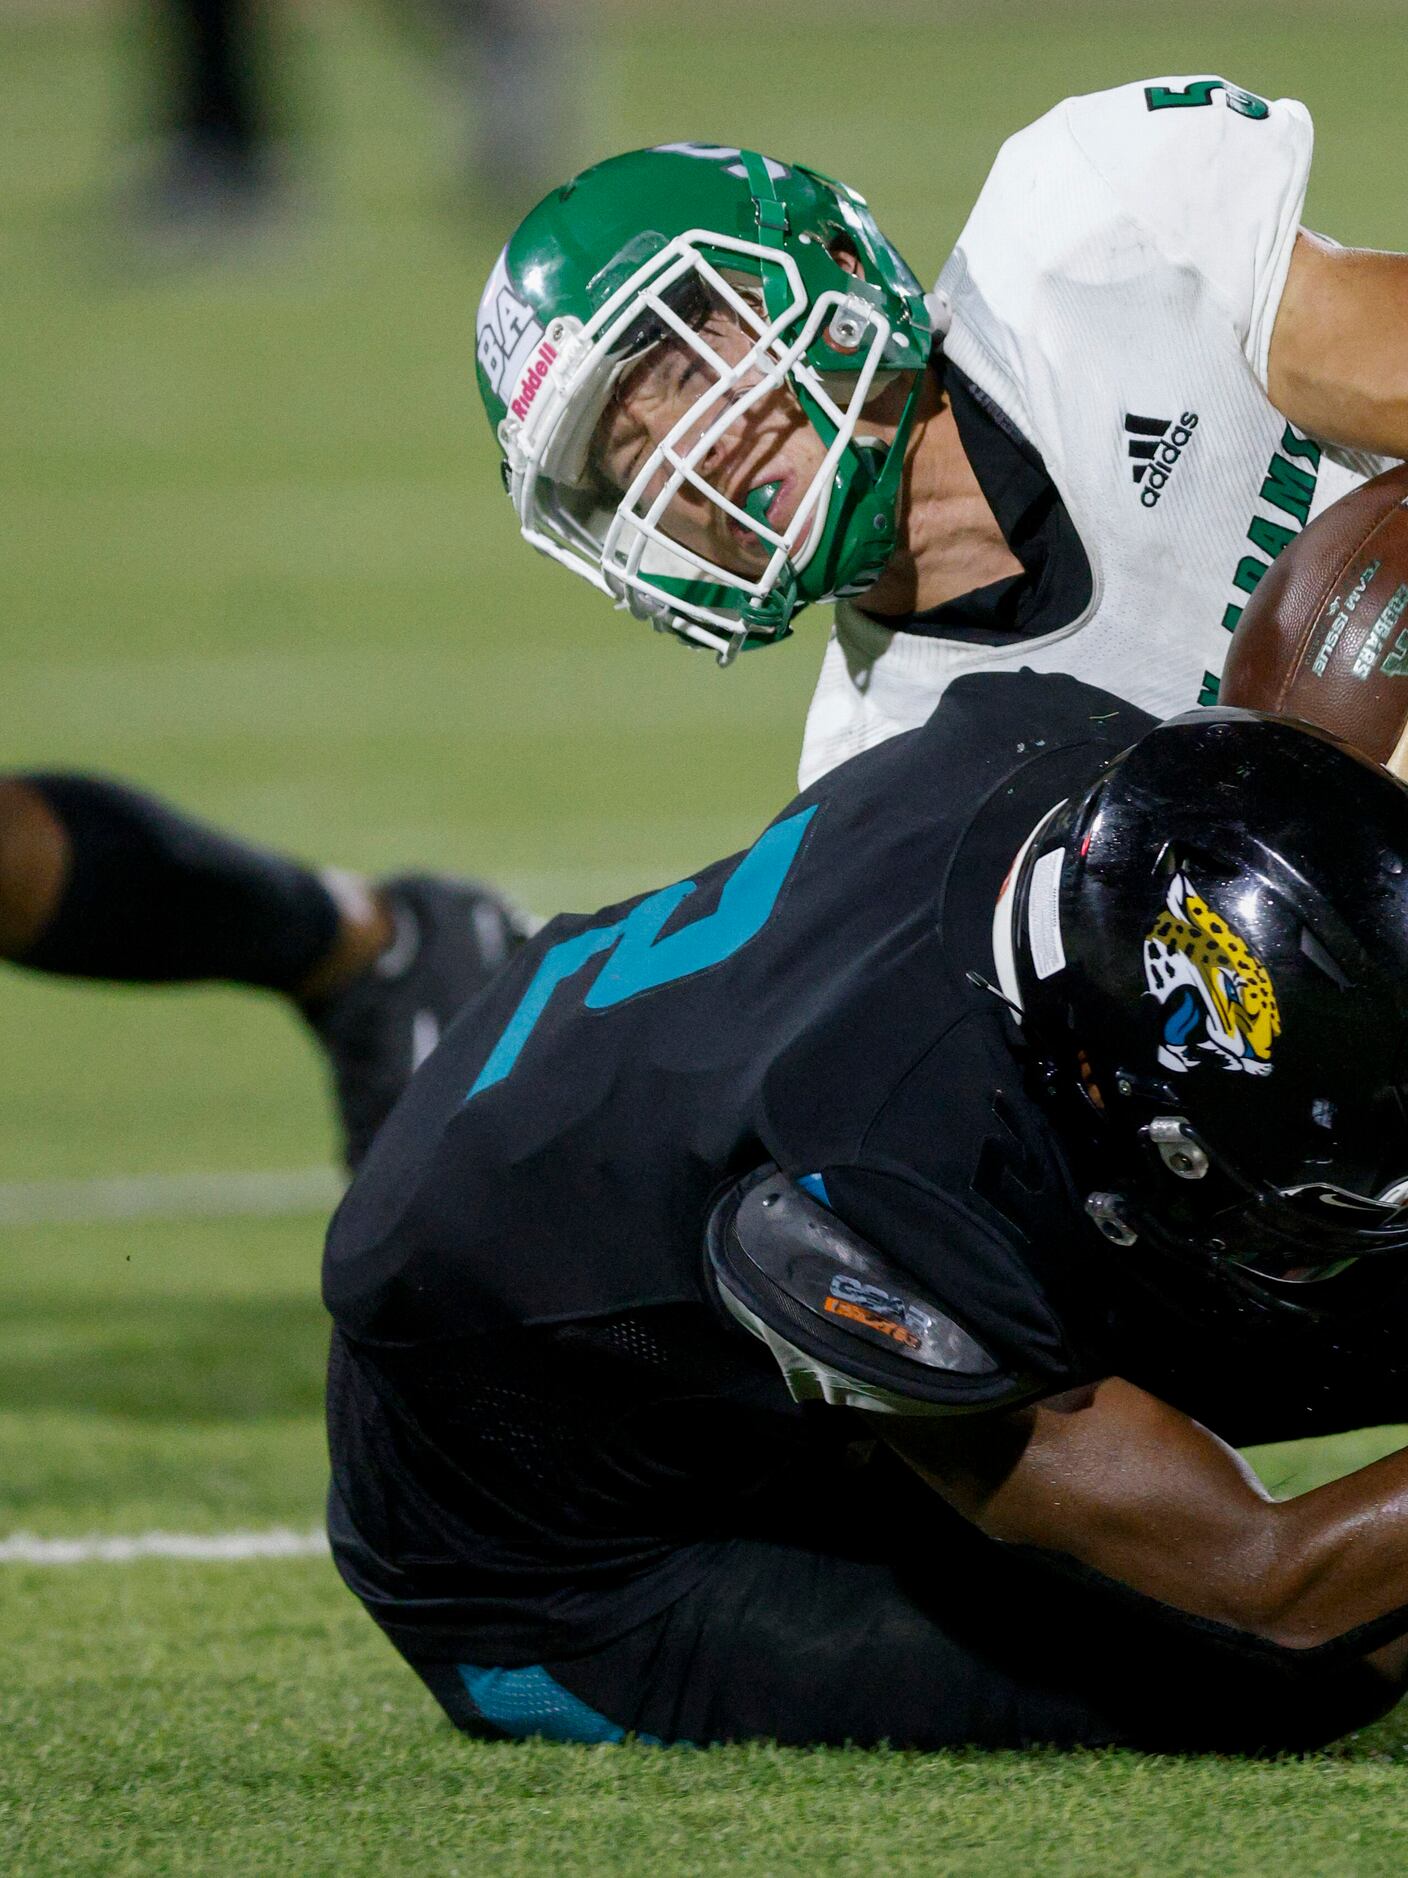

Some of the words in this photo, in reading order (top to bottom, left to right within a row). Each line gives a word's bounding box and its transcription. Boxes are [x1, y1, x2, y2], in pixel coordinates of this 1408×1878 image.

[477, 286, 535, 394] BA
[511, 342, 558, 421] Riddell
[1139, 411, 1198, 508] adidas
[1312, 609, 1350, 678] ISSUE
[829, 1274, 934, 1335] GEAR
